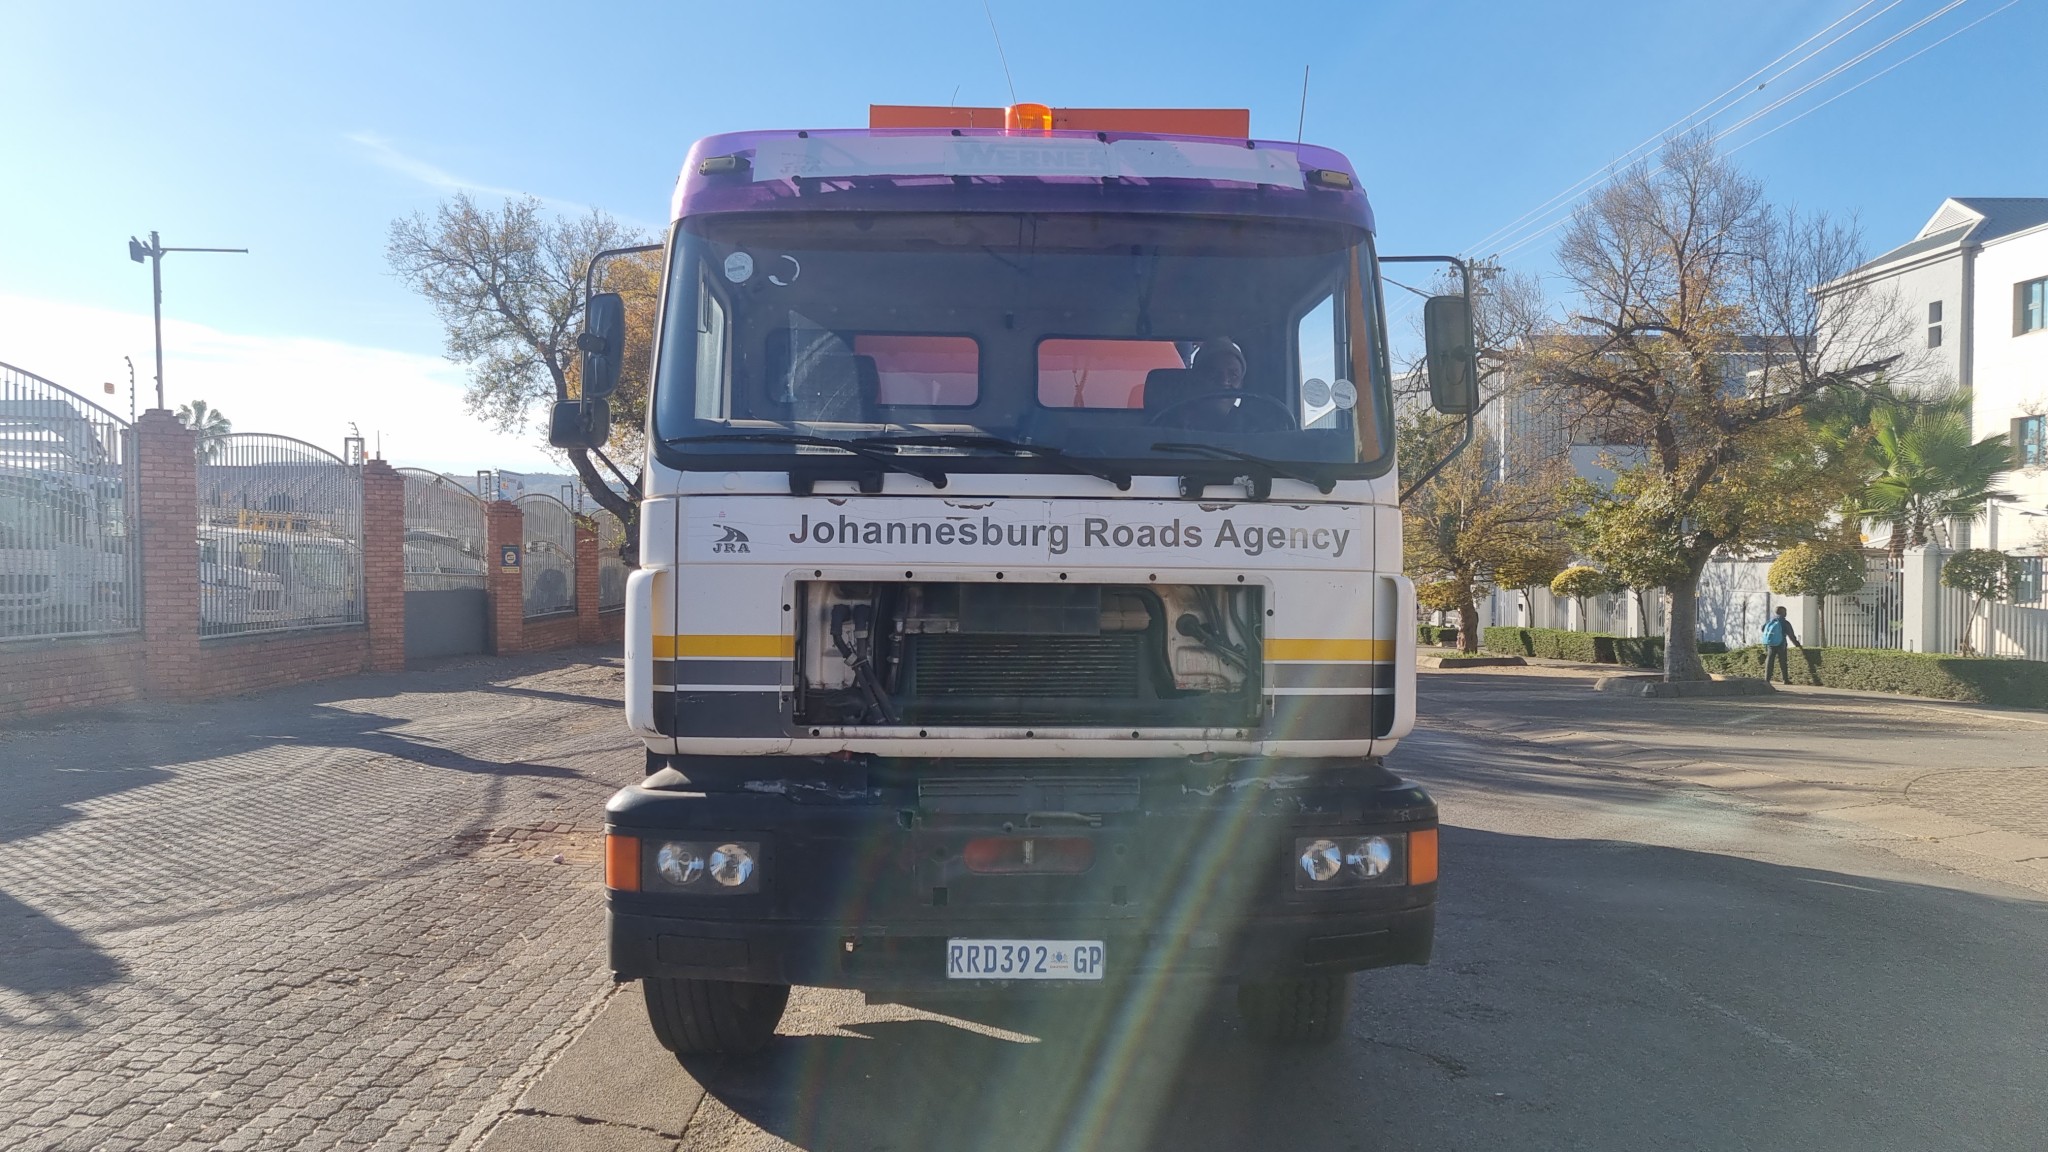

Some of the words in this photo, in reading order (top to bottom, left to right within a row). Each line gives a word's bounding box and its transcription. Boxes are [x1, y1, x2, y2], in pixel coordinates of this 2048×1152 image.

[712, 542, 751, 554] JRA
[789, 514, 1069, 554] Johannesburg
[1084, 518, 1202, 548] Roads
[1213, 519, 1350, 557] Agency
[950, 945, 1048, 973] RRD392
[1074, 946, 1102, 974] GP
